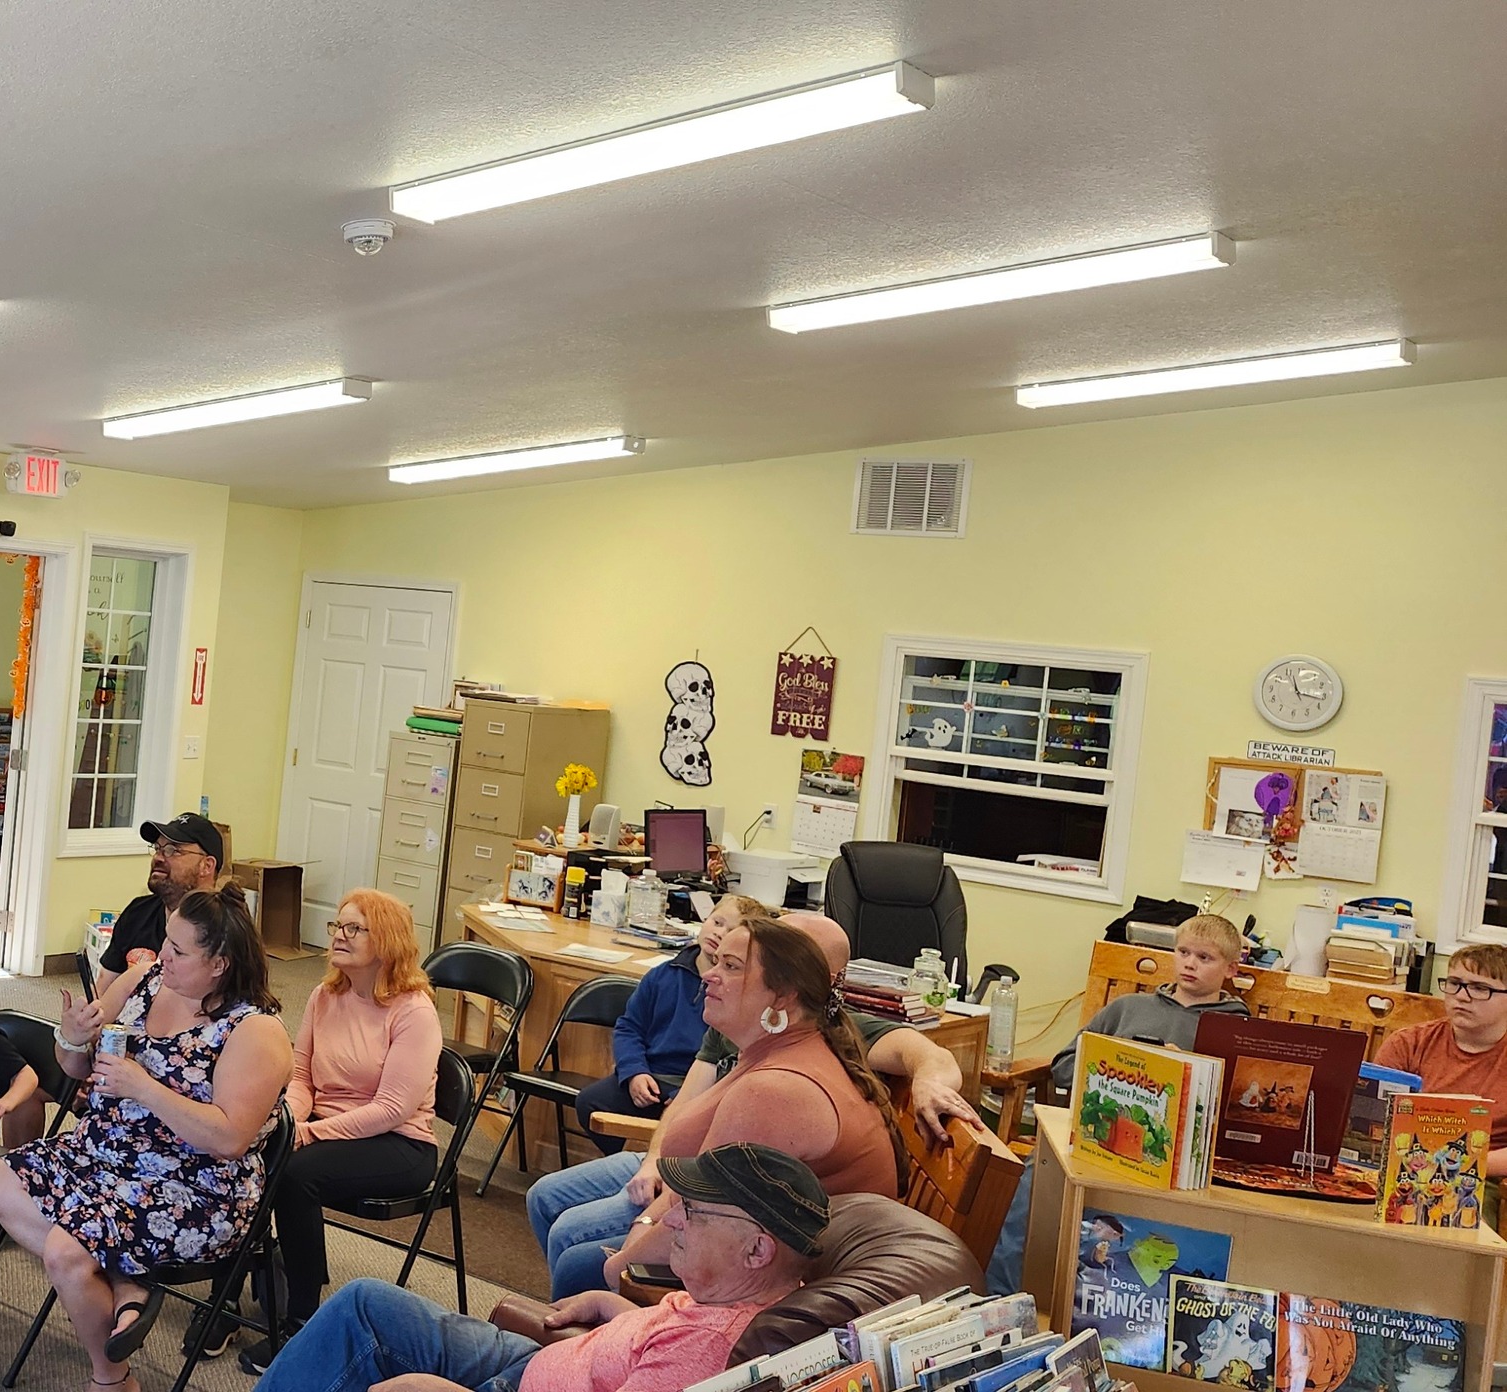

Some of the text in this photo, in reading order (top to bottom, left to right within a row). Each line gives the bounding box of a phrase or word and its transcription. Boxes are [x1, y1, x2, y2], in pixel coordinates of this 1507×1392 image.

[27, 456, 60, 495] EXIT
[90, 572, 124, 584] ourself
[778, 672, 828, 692] God Bless
[776, 711, 825, 730] FREE
[1253, 742, 1329, 757] BEWARE OF
[1252, 751, 1331, 766] ATTACK LIBRARIAN
[1124, 1057, 1140, 1068] Legend
[1096, 1060, 1165, 1097] Spookley
[1098, 1079, 1159, 1107] the Square Pumpkin
[1418, 1115, 1467, 1125] Which Witch
[1432, 1127, 1462, 1135] Which?
[1111, 1277, 1141, 1291] Does
[1081, 1283, 1169, 1322] FRANKEN
[1176, 1297, 1276, 1332] GHOST OF THE FO
[1293, 1300, 1443, 1334] The Little Old Lady Who
[1125, 1320, 1146, 1334] Get
[1284, 1311, 1456, 1350] Was Not Afraid Of Anything
[956, 1332, 969, 1342] BOOK
